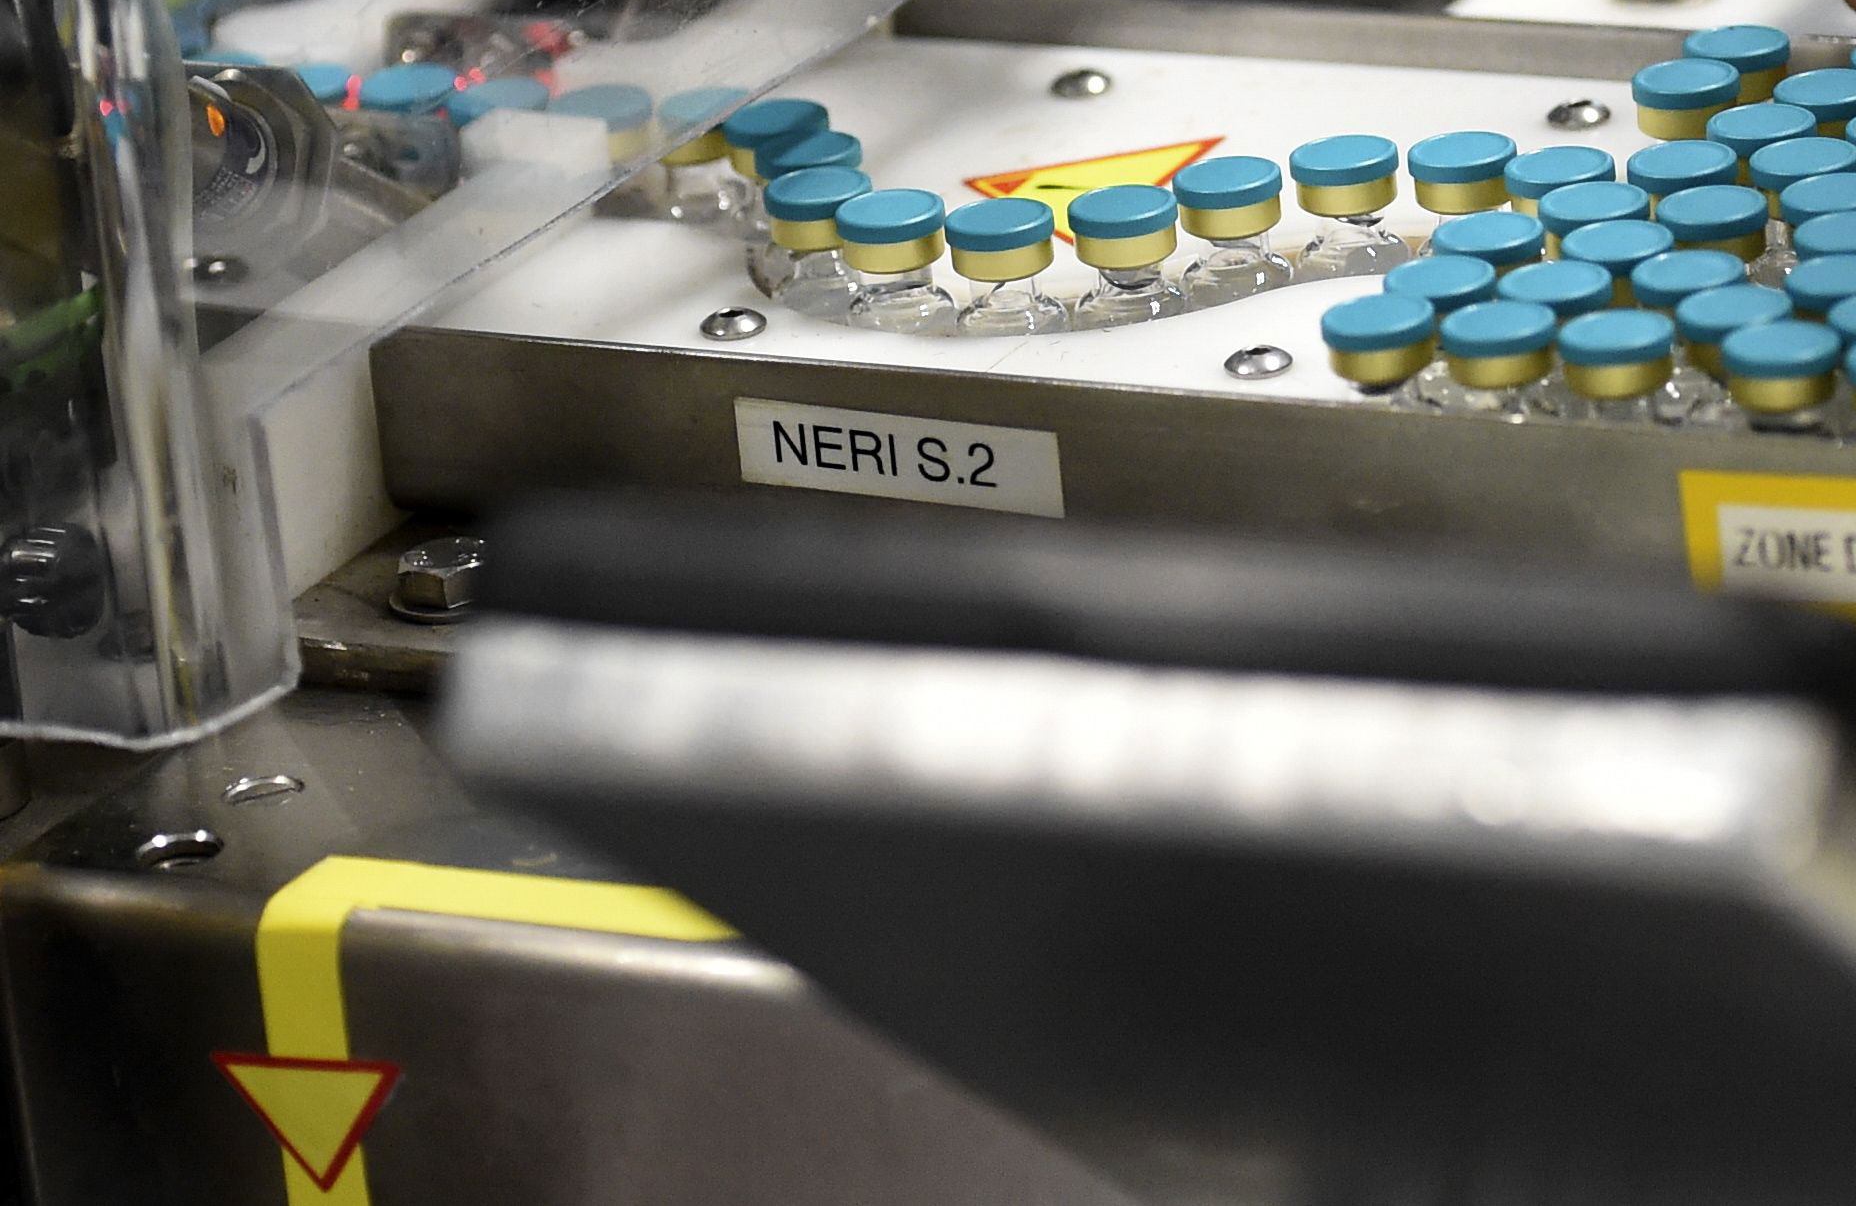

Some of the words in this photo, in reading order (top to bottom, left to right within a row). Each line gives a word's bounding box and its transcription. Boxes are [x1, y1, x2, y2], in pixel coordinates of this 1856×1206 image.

[772, 419, 898, 477] NERI
[916, 436, 998, 489] S.2
[1733, 526, 1832, 574] ZONE
